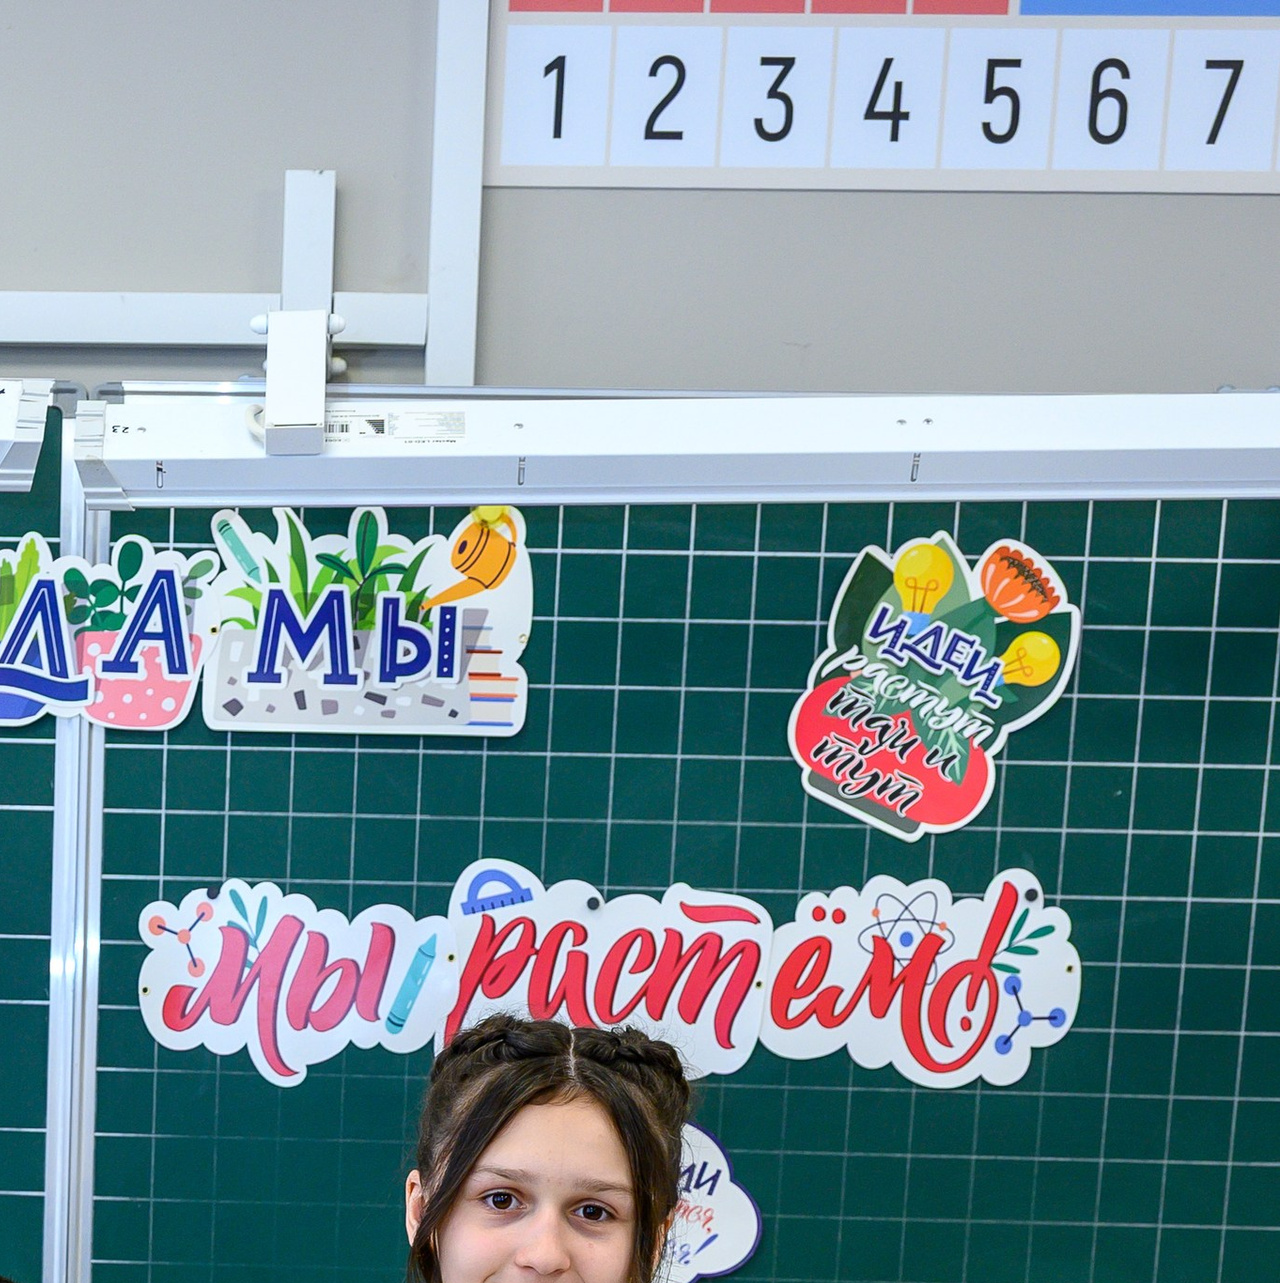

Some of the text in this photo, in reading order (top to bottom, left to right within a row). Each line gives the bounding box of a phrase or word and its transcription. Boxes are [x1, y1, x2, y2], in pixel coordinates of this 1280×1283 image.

[542, 55, 1245, 145] 1 2 3 4 5 6 7
[820, 643, 996, 750] растут
[868, 606, 1003, 706] ИДЕИ
[811, 732, 924, 818] тут
[826, 683, 960, 782] там и
